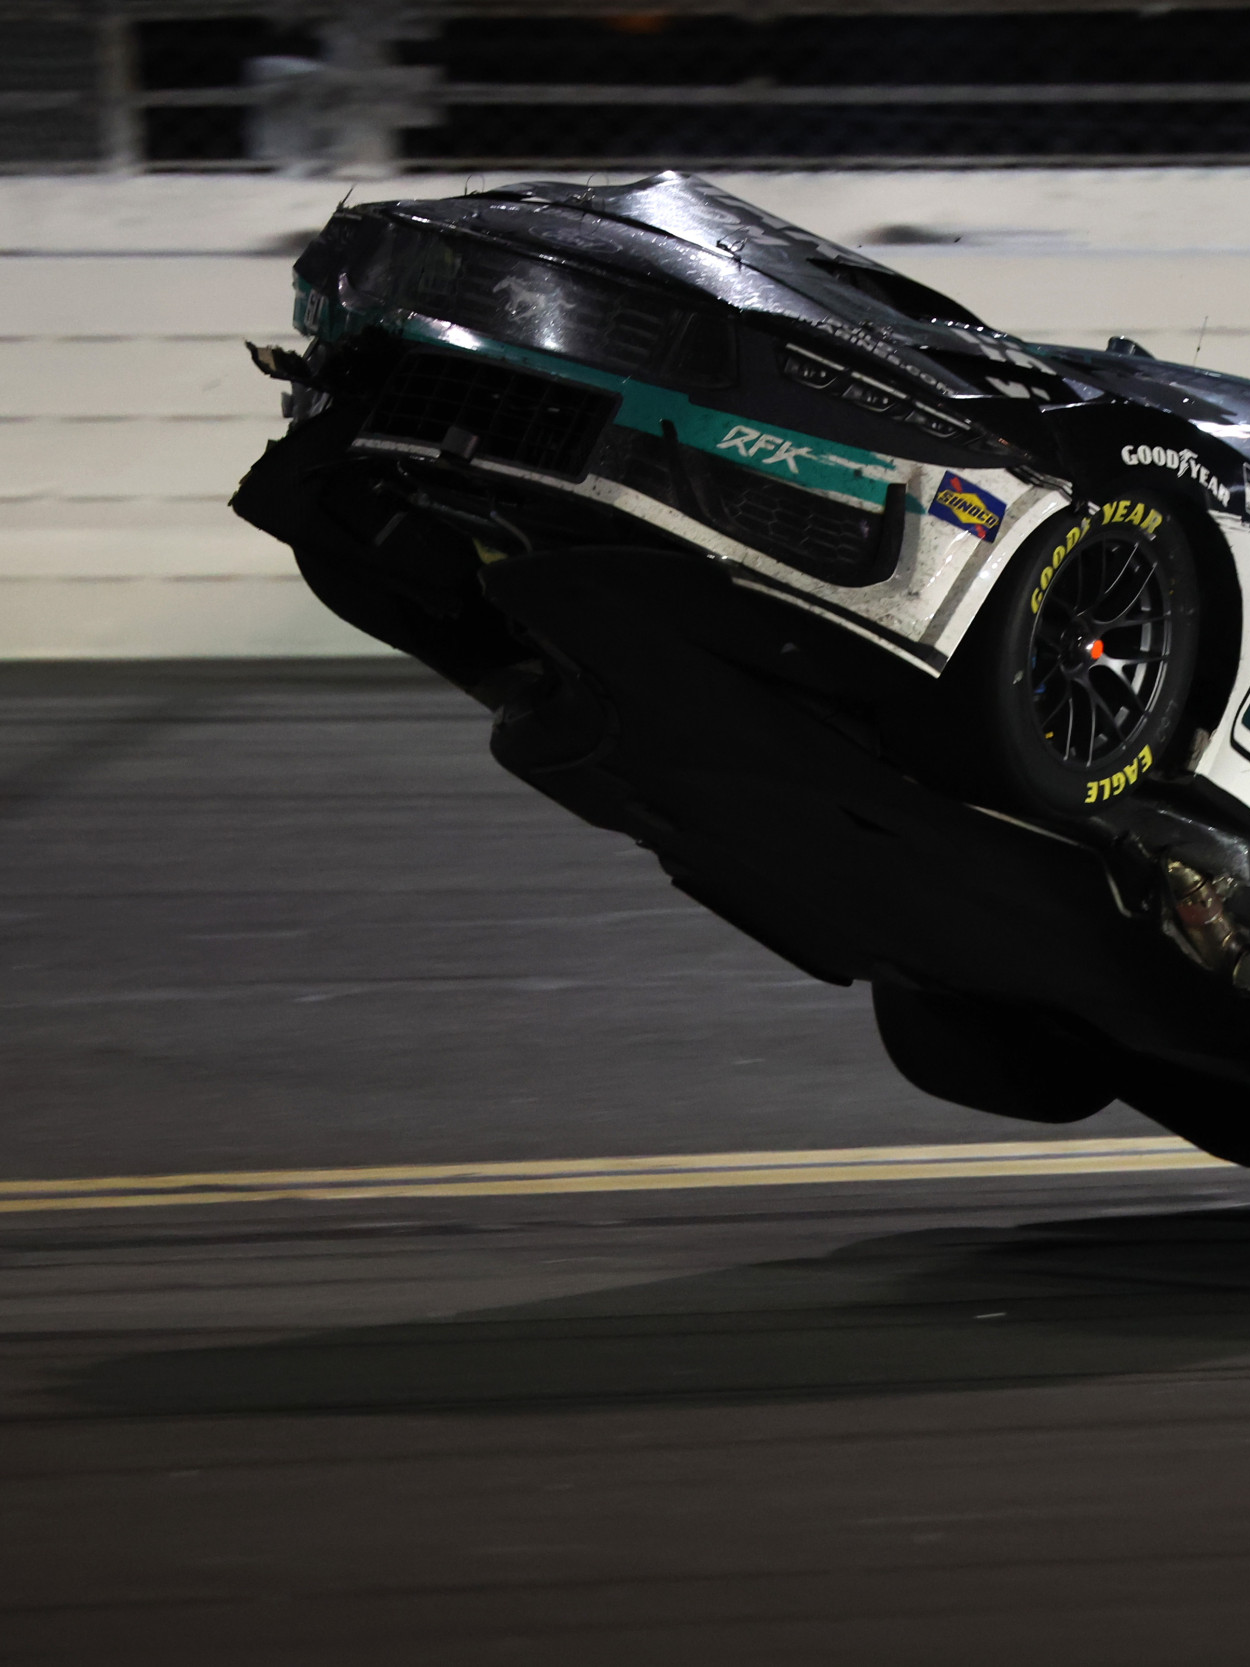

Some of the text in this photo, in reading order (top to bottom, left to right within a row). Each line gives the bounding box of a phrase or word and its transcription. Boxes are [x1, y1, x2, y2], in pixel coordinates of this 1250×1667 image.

[716, 425, 812, 474] RFK
[1121, 445, 1231, 507] GOODYEAR
[937, 490, 1000, 529] SUNOCO
[1085, 744, 1153, 803] EAGLE
